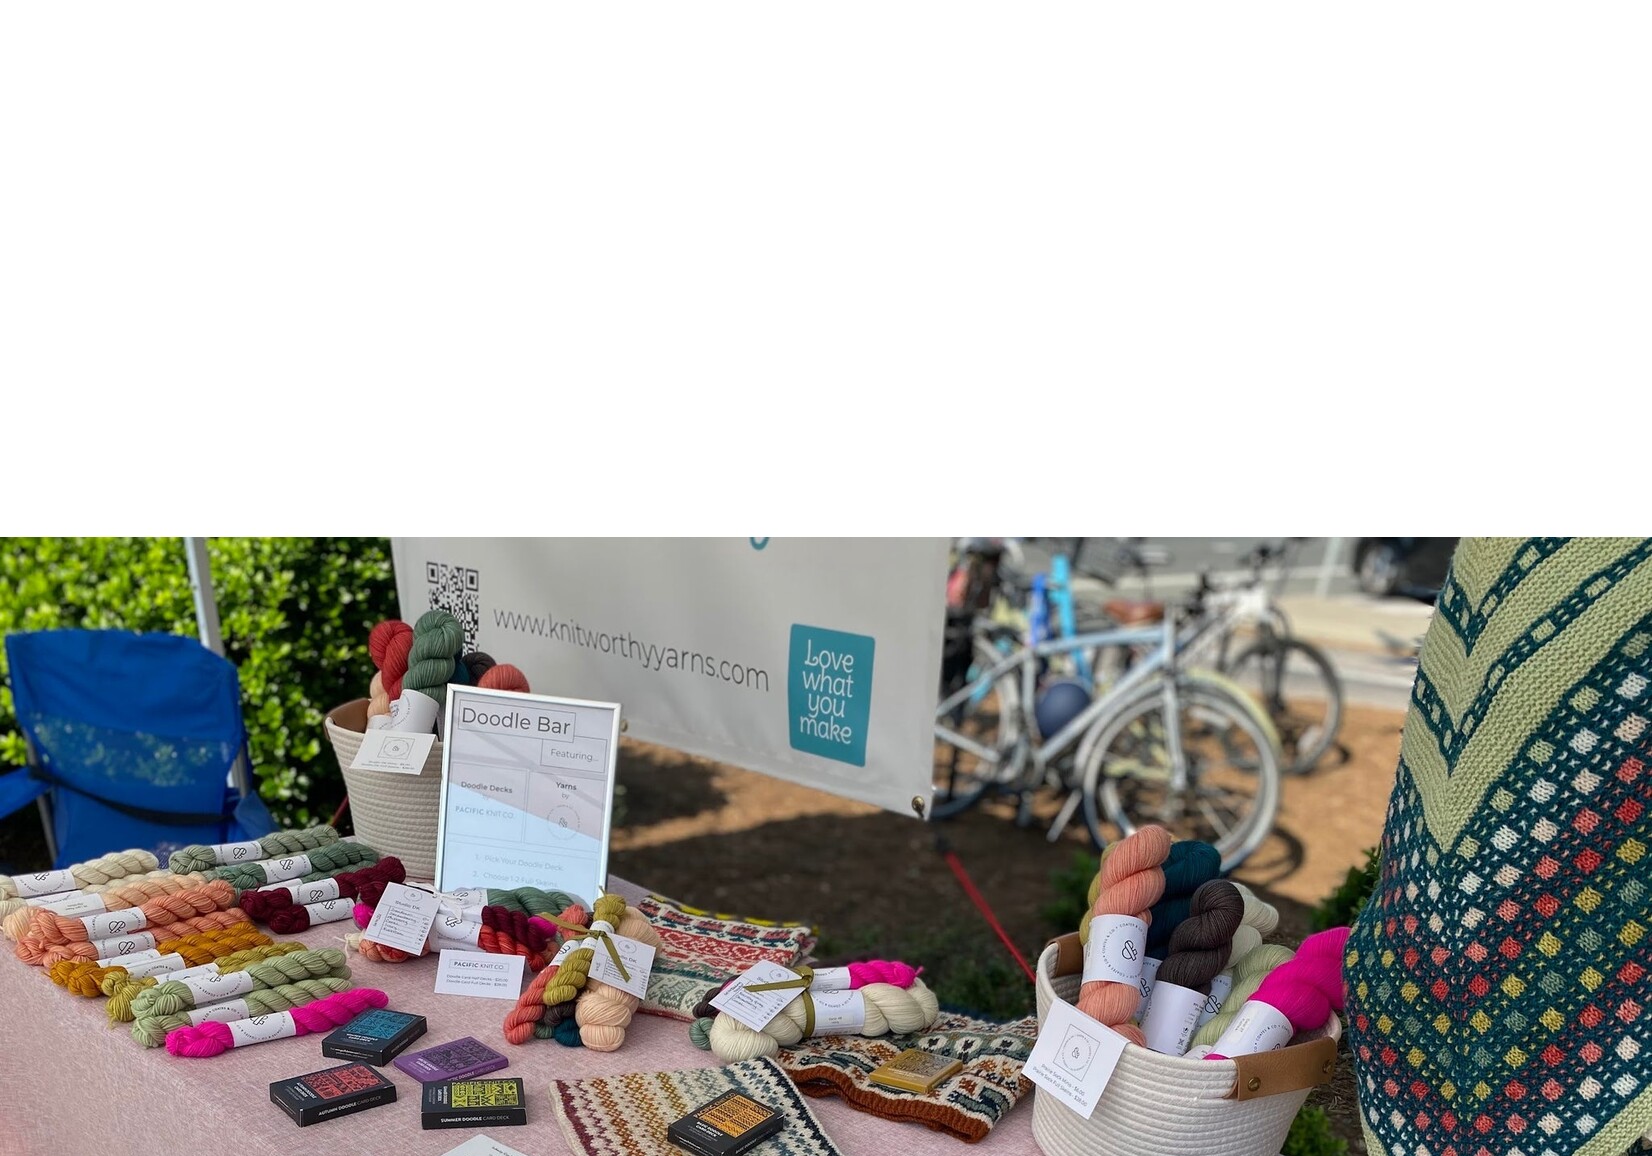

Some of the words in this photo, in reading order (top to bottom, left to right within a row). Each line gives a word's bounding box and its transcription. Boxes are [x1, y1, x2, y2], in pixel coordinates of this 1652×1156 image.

[494, 608, 769, 692] www.knitworthyyarns.com
[804, 639, 855, 673] Love
[802, 669, 855, 698] what
[808, 693, 846, 718] you
[461, 707, 531, 730] Doodle
[537, 716, 571, 734] Bar
[800, 716, 852, 744] make
[460, 781, 488, 791] Doodle
[489, 784, 513, 794] Decks
[556, 781, 577, 791] Yarns
[455, 805, 485, 816] PACIFIC
[485, 809, 502, 817] KNIT
[484, 854, 498, 863] Pick
[458, 1071, 475, 1080] DOODLE
[318, 1107, 338, 1116] AUTUMN
[338, 1102, 357, 1111] DOODLE
